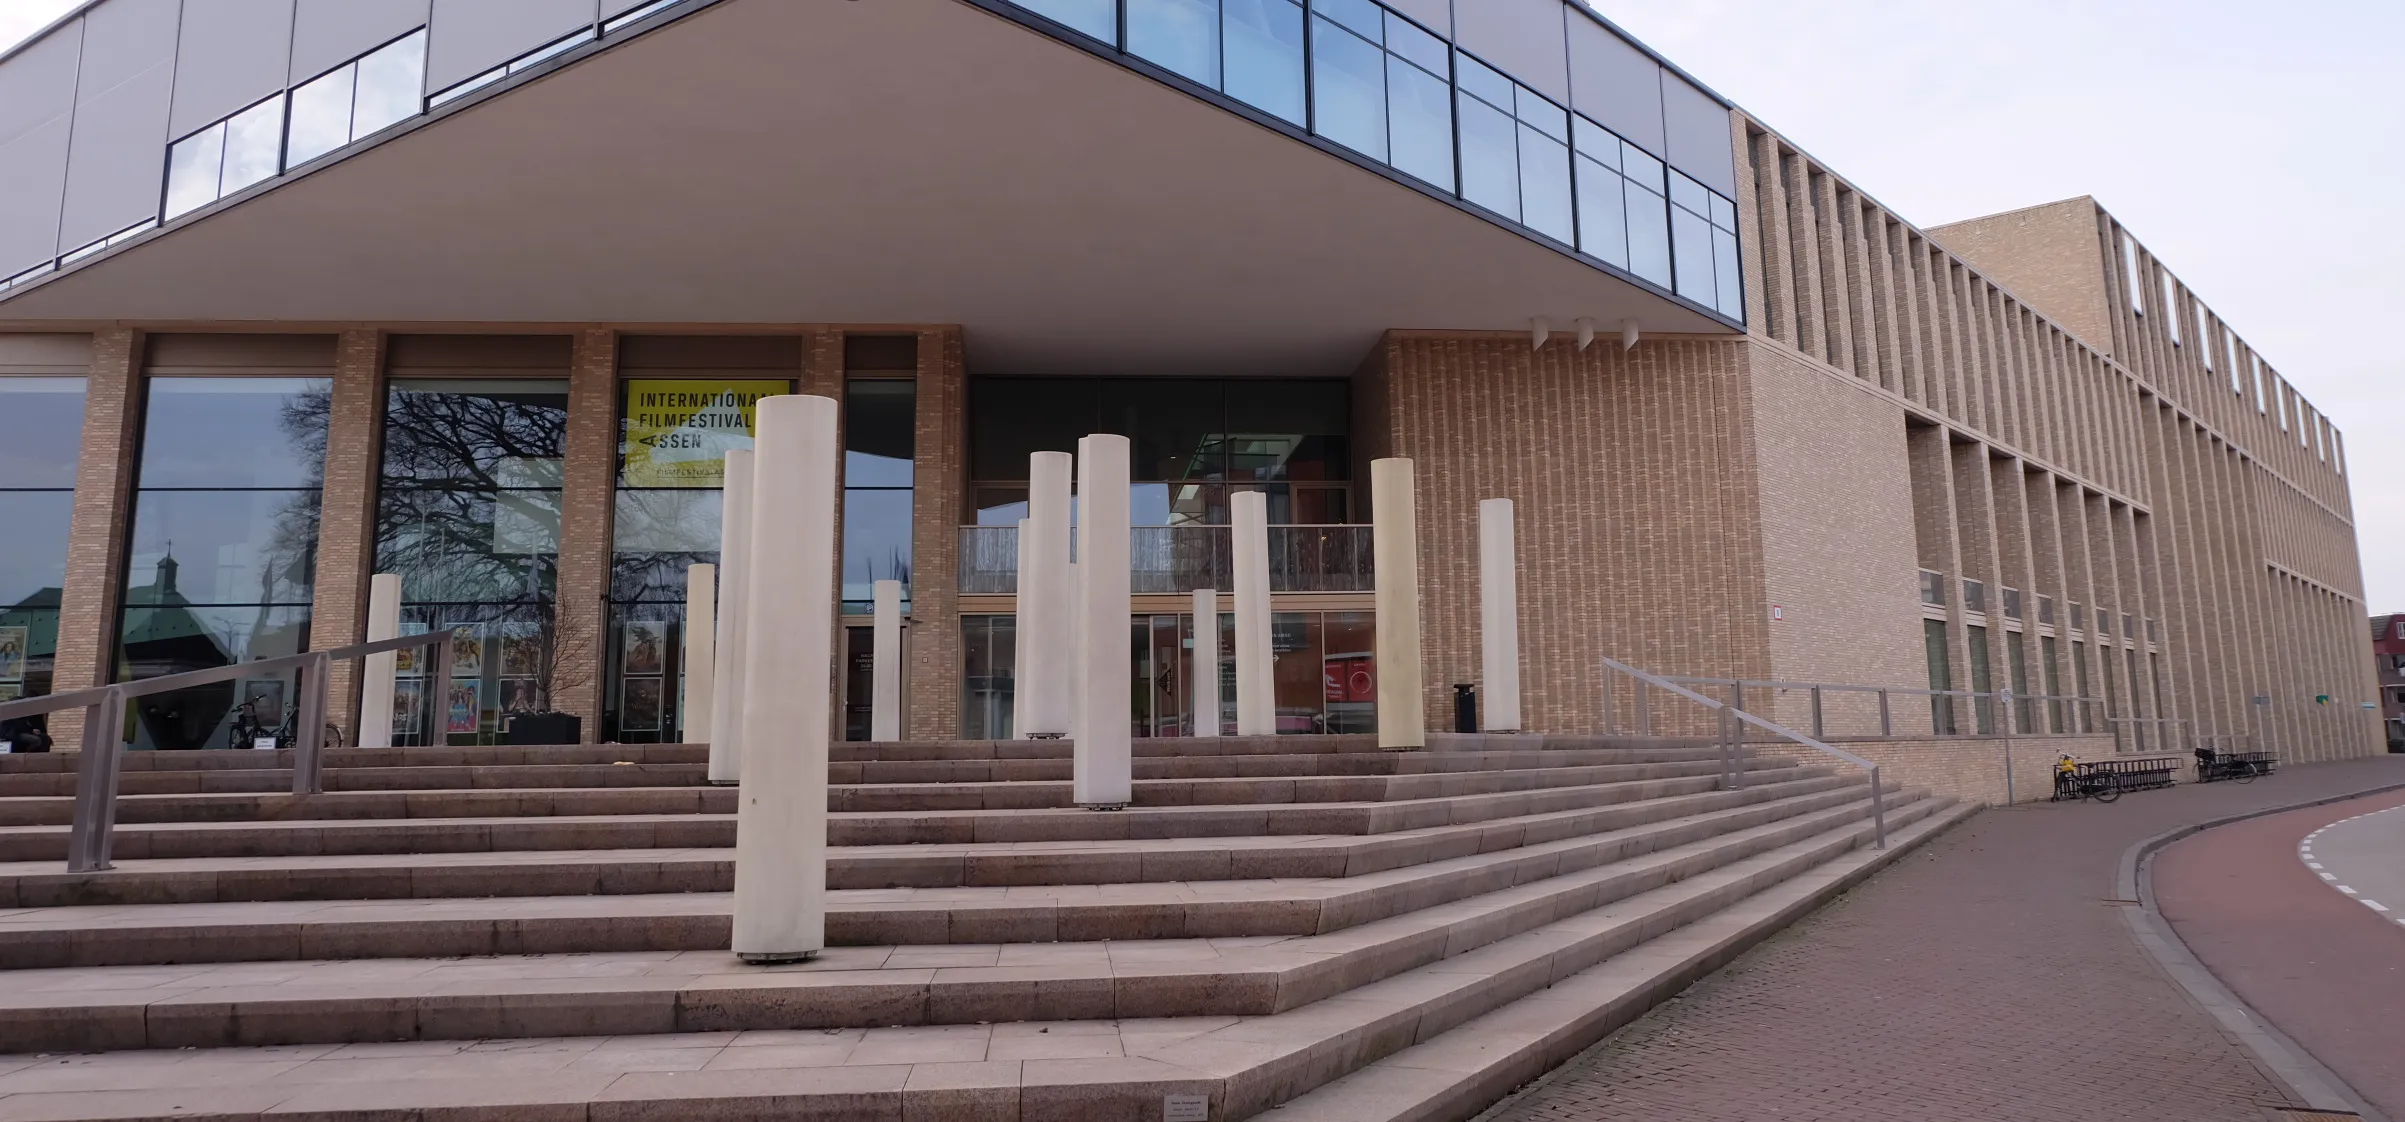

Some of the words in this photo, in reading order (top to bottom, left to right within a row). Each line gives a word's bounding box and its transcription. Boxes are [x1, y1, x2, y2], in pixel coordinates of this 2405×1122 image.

[640, 392, 775, 408] INTERNATIONA
[639, 413, 752, 428] FILMFESTIVAL
[639, 433, 701, 449] ASSEN
